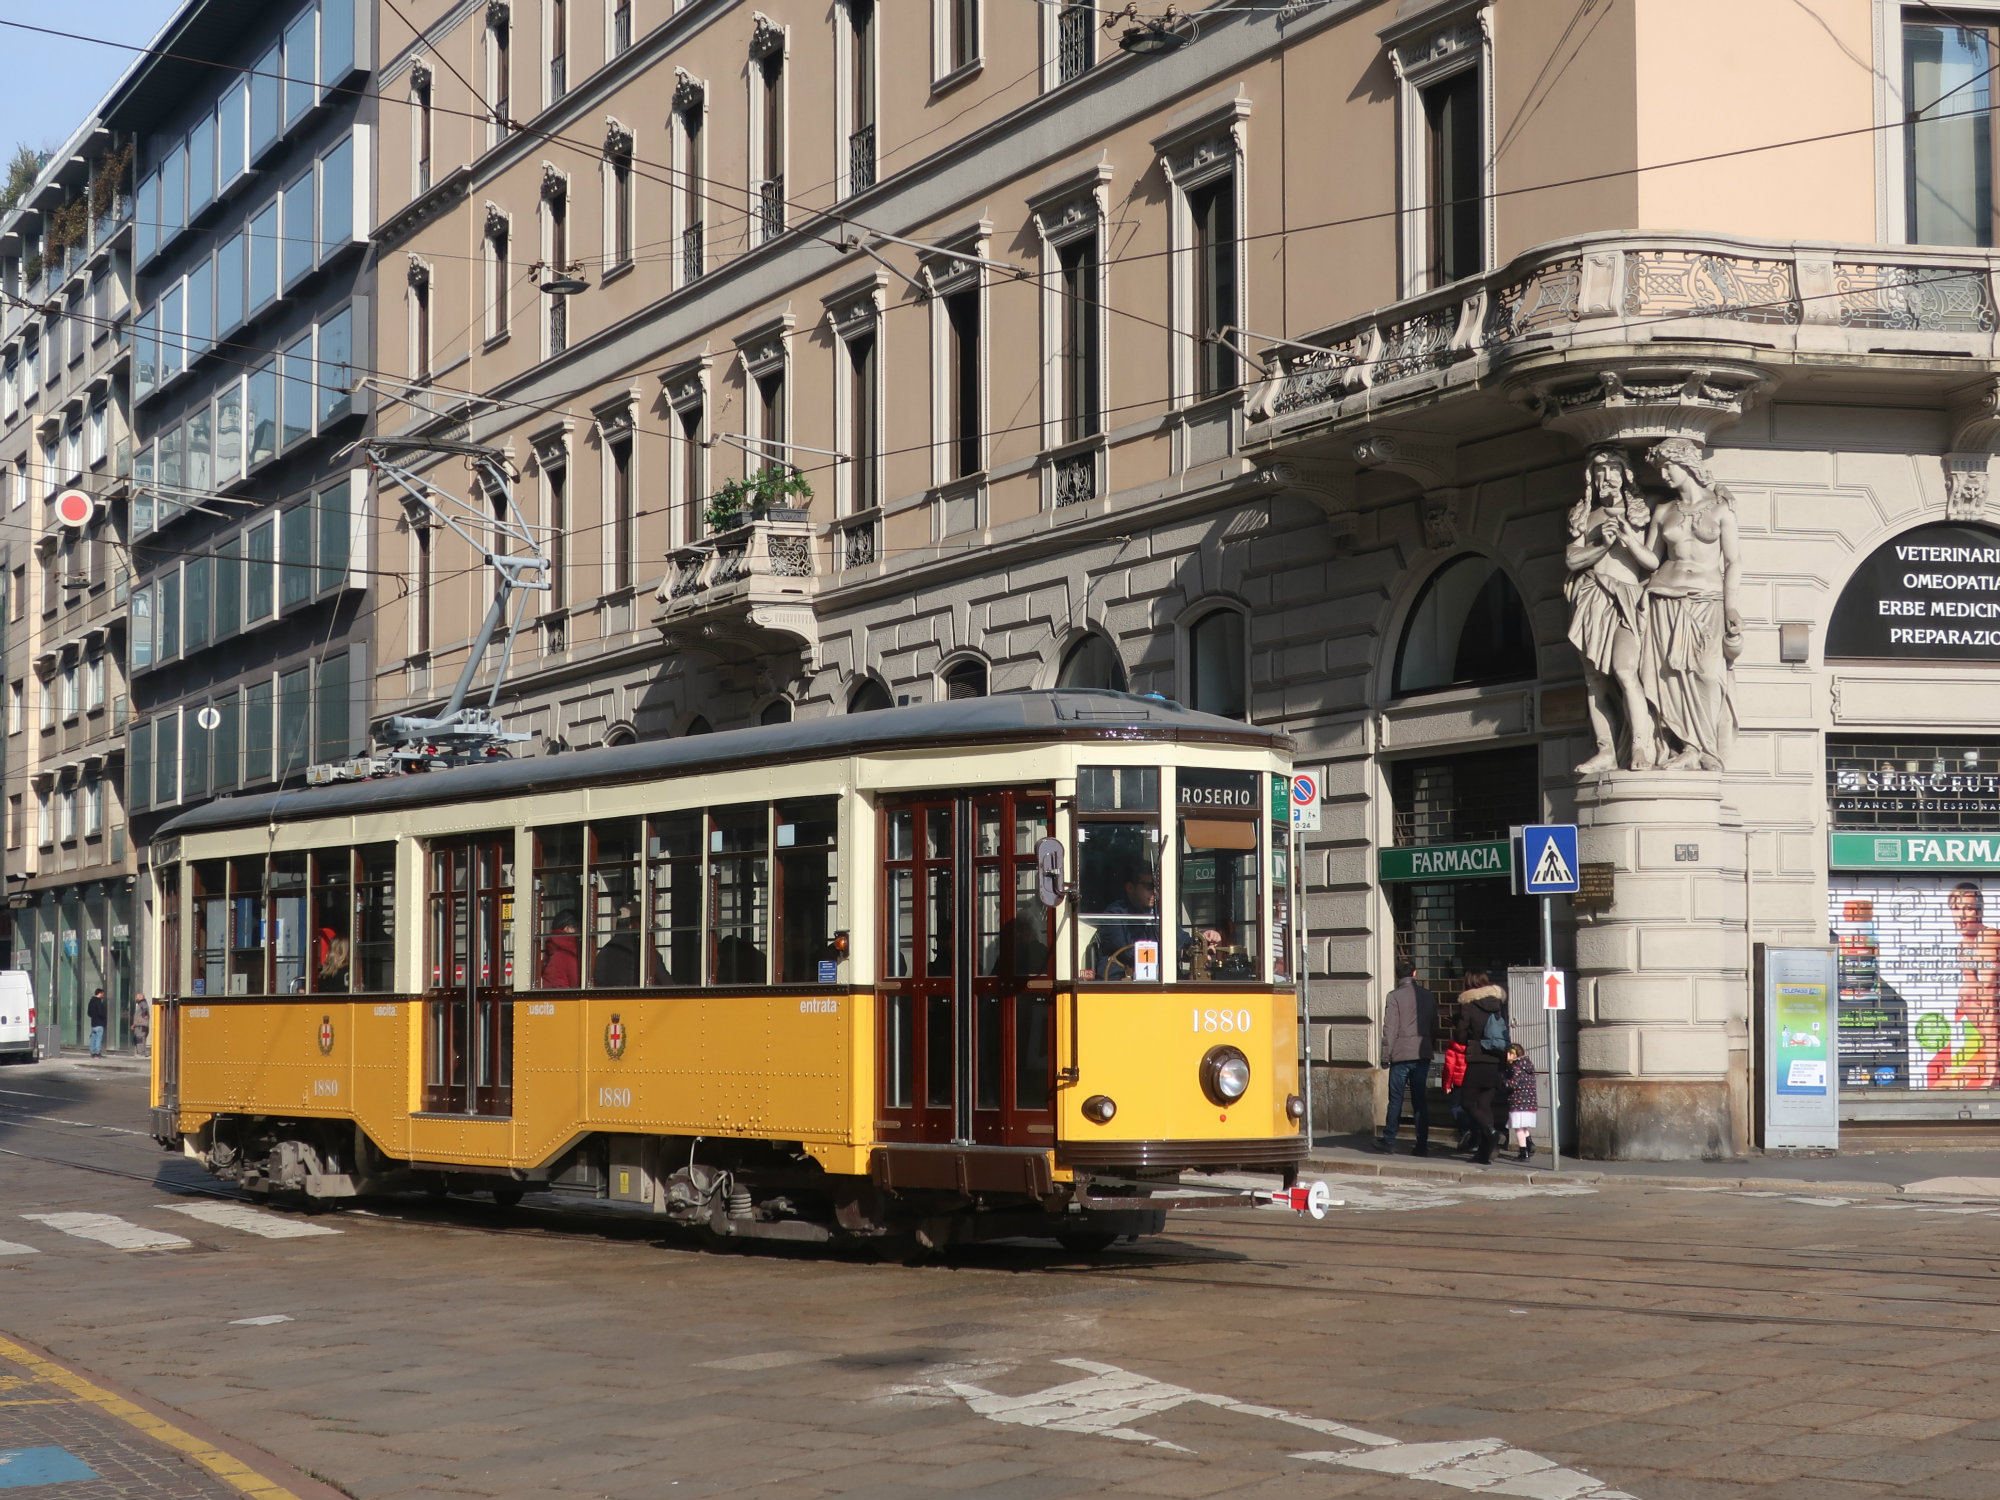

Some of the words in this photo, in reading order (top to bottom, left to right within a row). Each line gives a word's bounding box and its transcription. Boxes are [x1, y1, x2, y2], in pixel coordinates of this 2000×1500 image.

[1879, 600, 1926, 616] ERBE
[1182, 787, 1250, 805] ROSERIO
[1412, 848, 1501, 873] FARMACIA
[1143, 949, 1149, 963] 1
[1143, 965, 1149, 978] 1
[529, 1002, 555, 1015] uscita
[800, 998, 837, 1013] entrata
[1192, 1009, 1252, 1032] 1880
[313, 1080, 338, 1097] 1880
[599, 1087, 631, 1108] 1880
